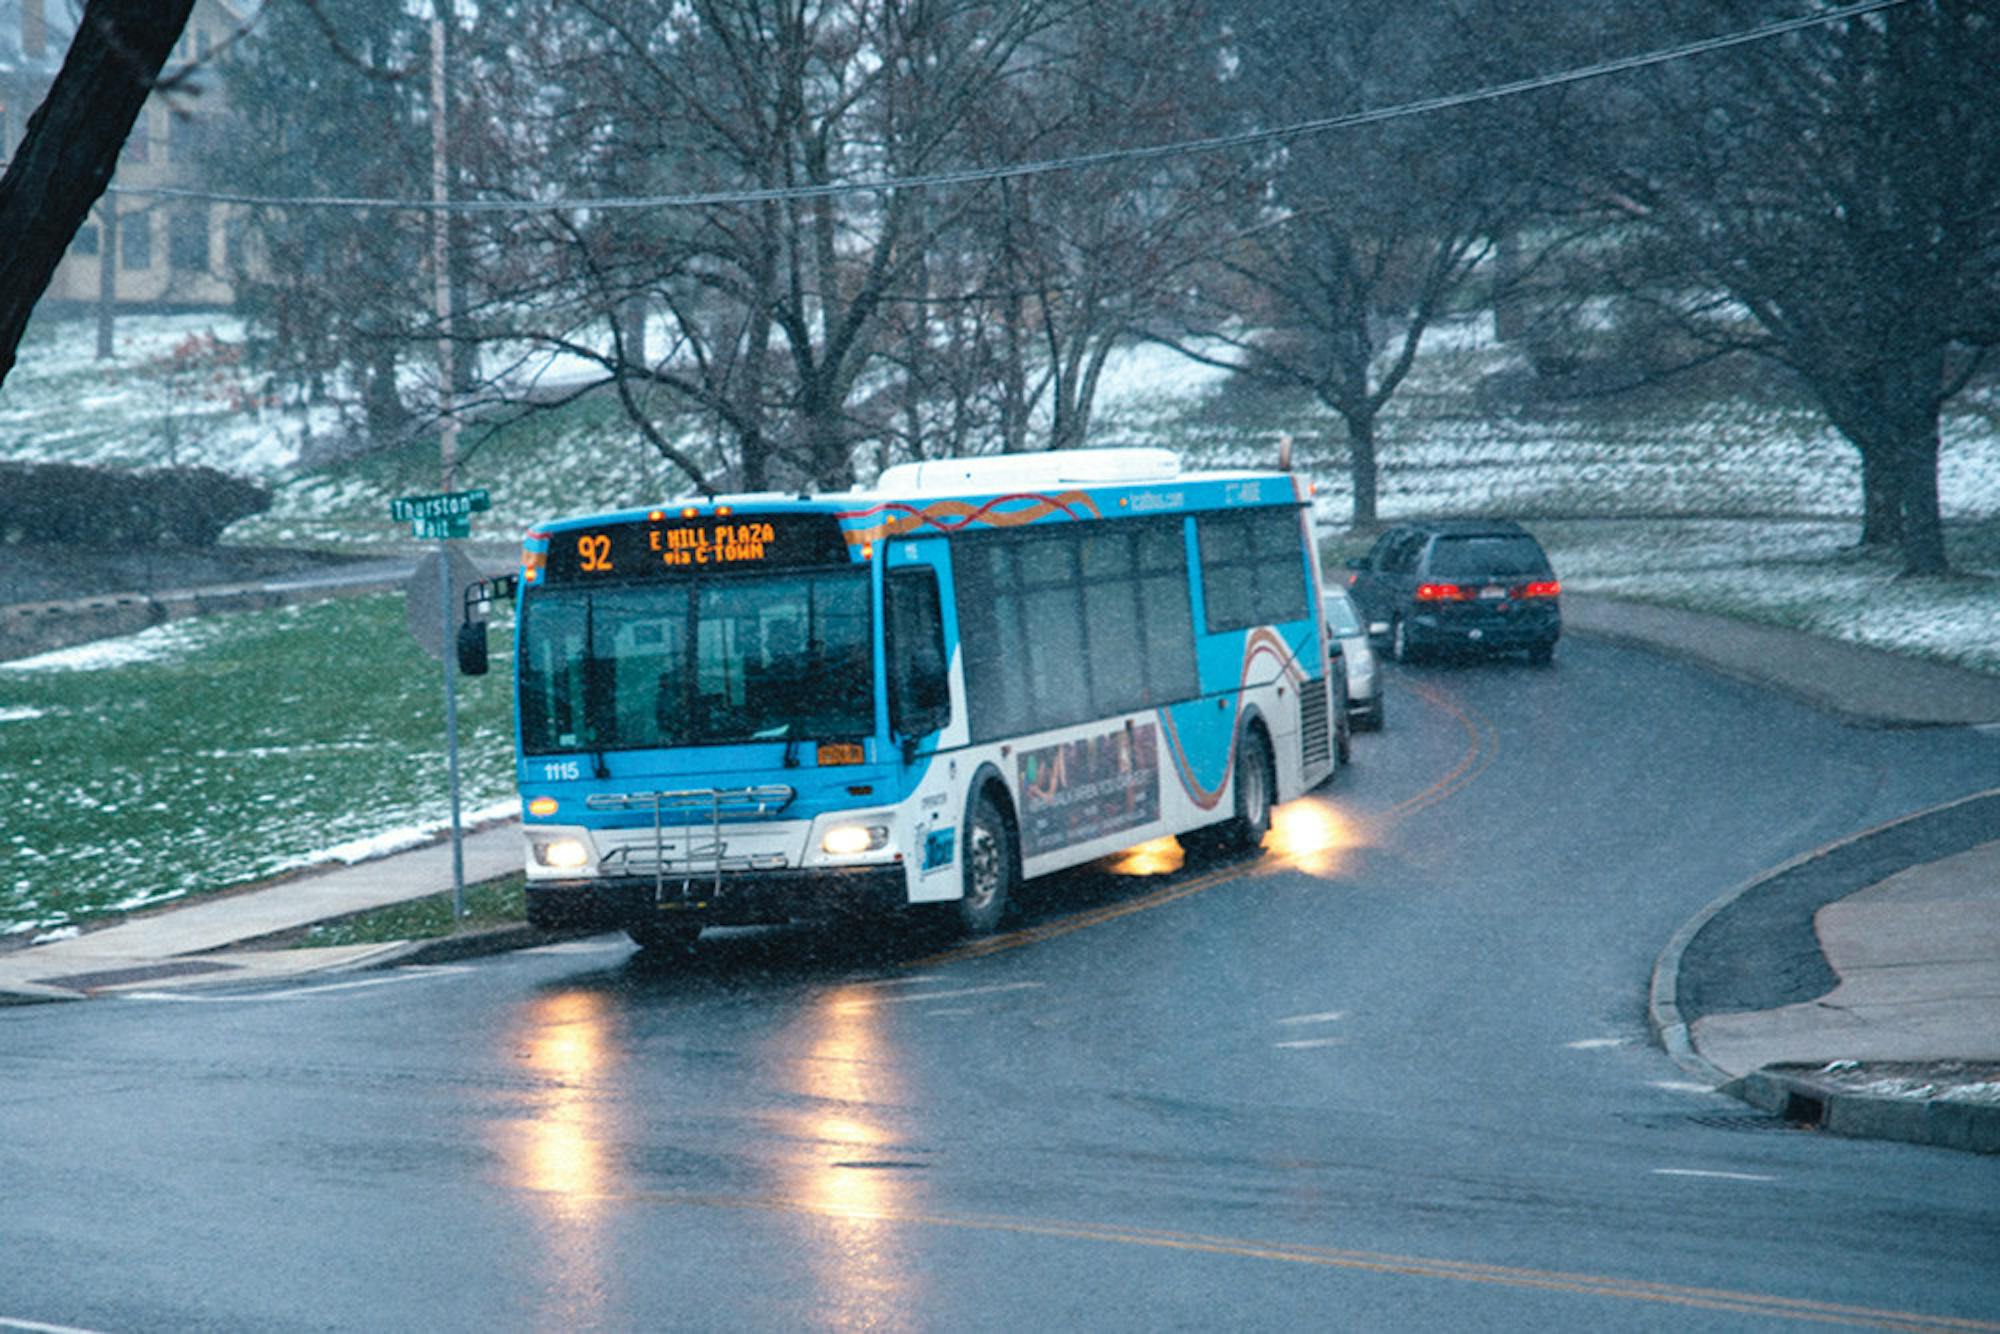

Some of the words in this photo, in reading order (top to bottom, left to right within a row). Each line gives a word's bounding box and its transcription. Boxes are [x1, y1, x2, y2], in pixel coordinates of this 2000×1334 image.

[649, 530, 662, 551] E
[667, 527, 710, 549] HILL
[715, 523, 775, 546] PLAZA
[578, 535, 613, 571] 92
[544, 762, 580, 780] 1115
